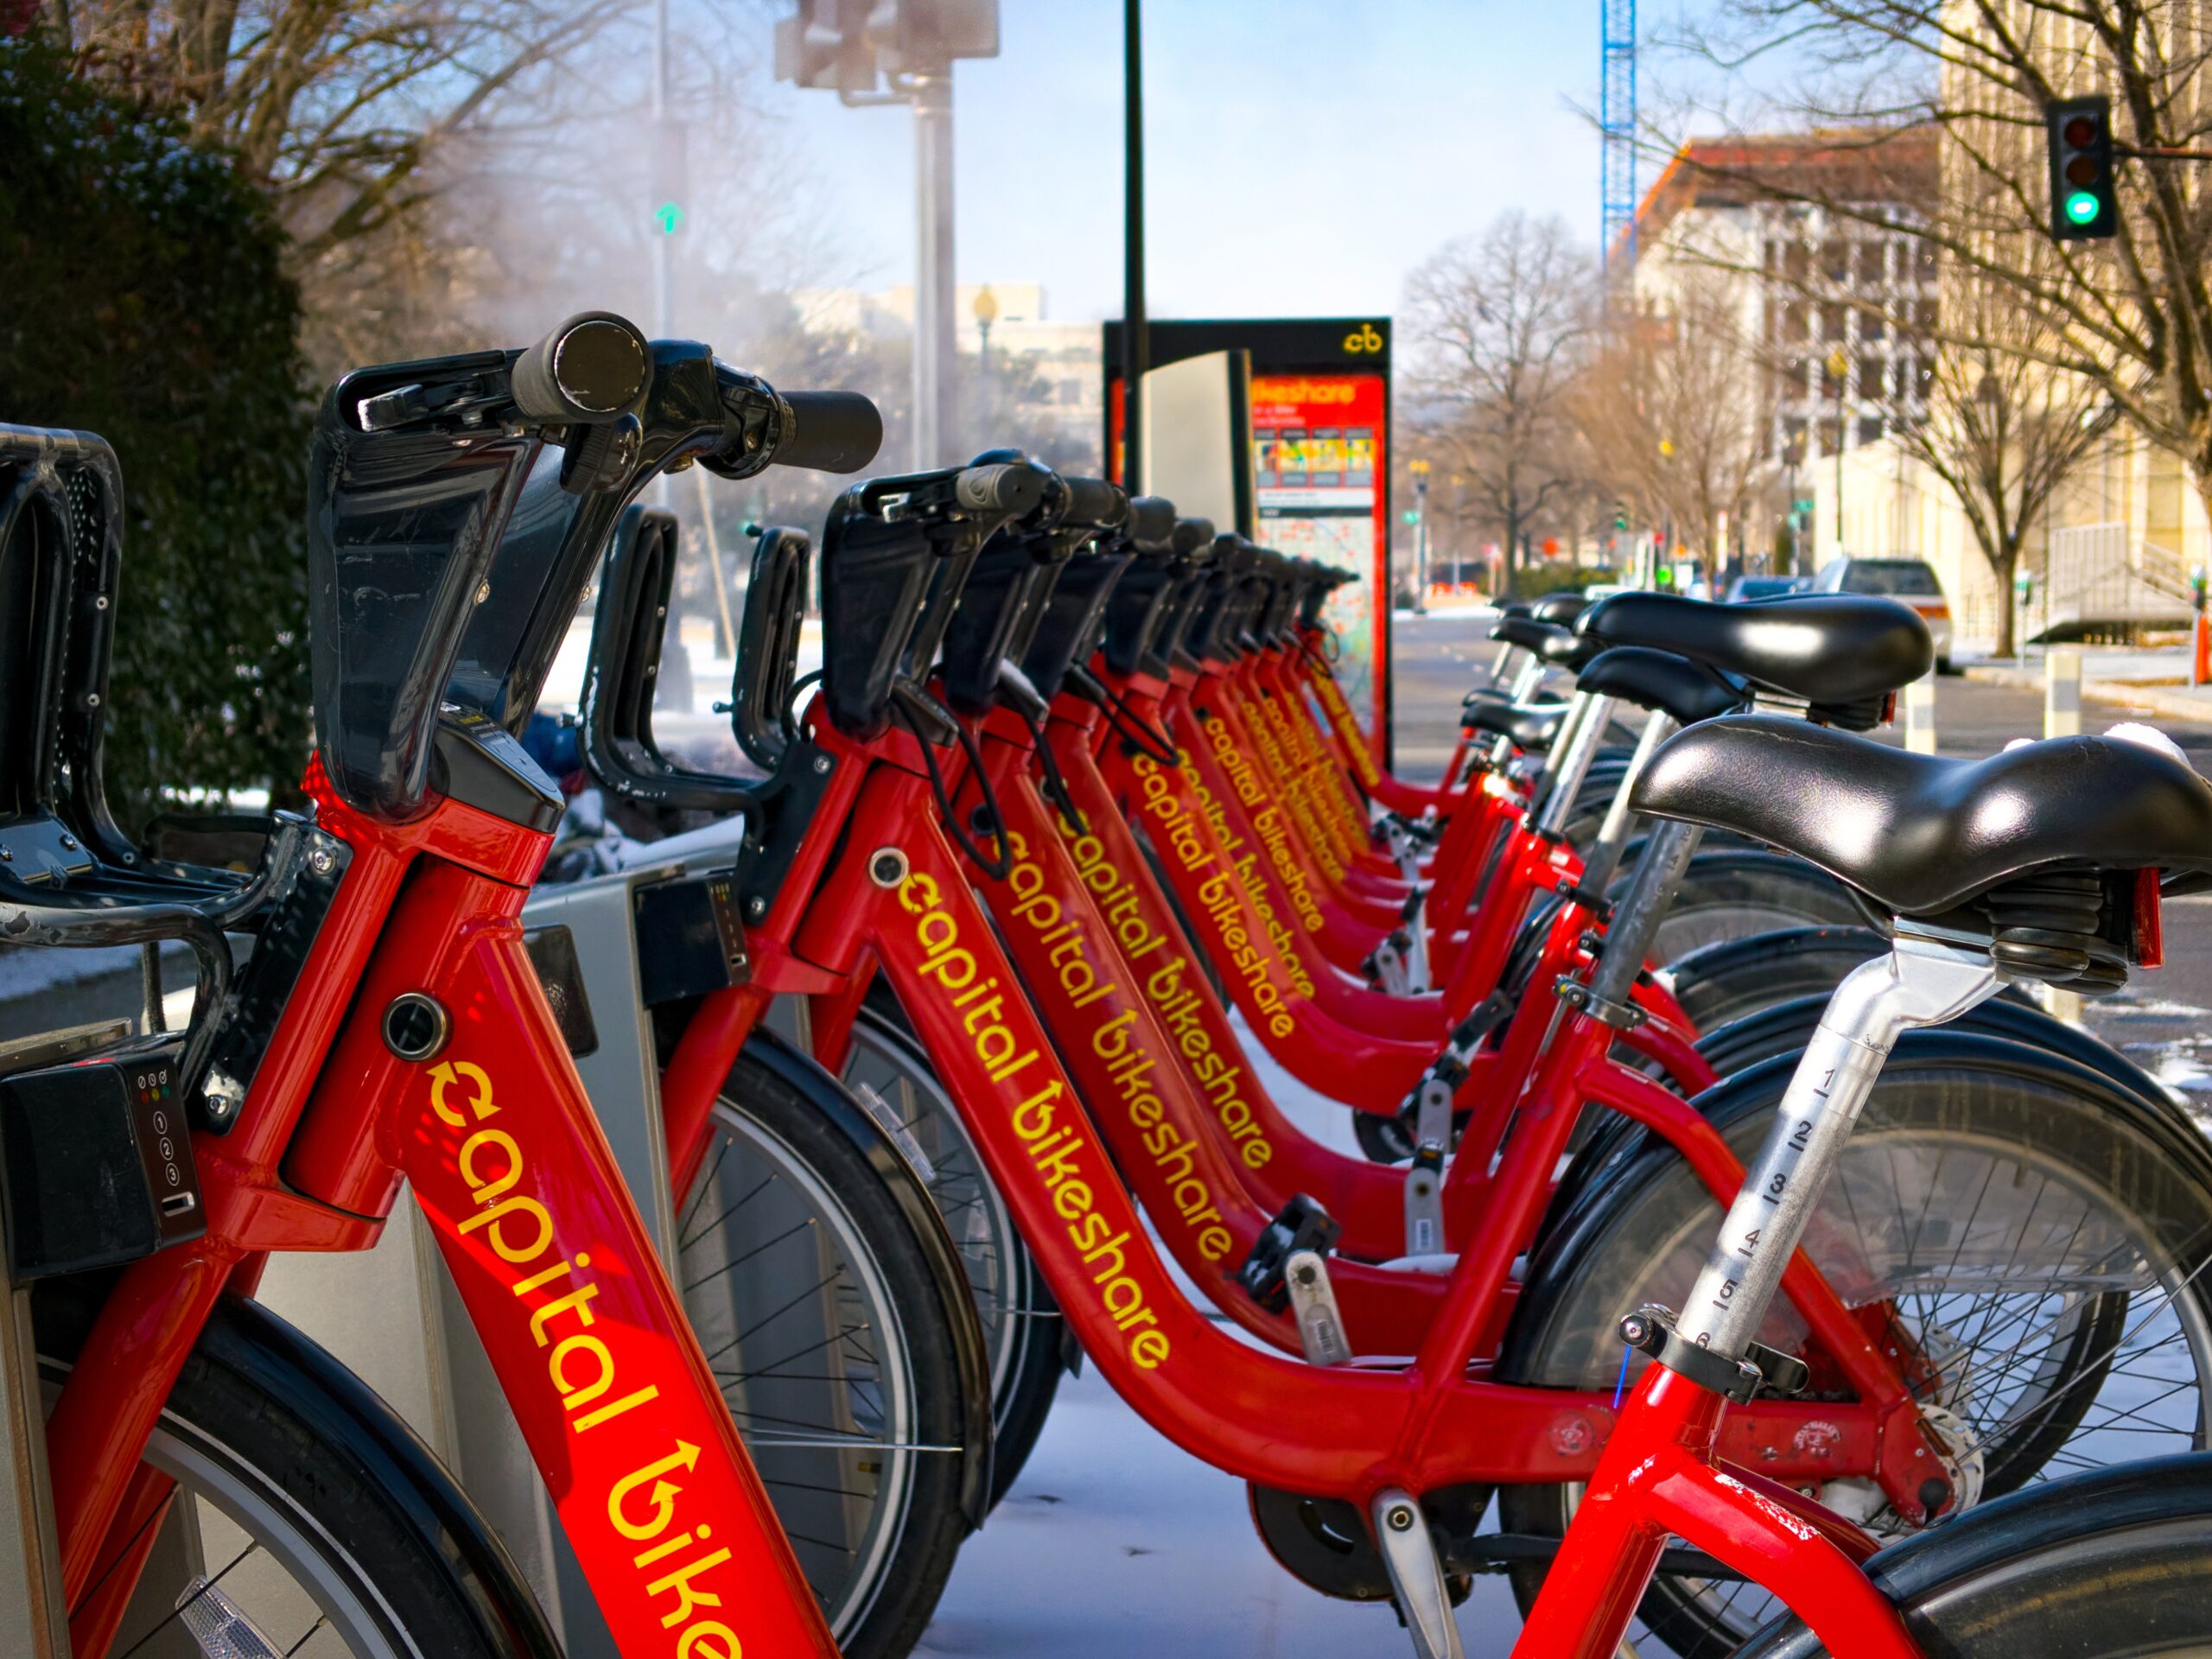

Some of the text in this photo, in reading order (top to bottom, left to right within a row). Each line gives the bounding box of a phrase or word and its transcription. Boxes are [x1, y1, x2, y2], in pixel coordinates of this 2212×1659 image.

[1344, 323, 1382, 353] cb
[1206, 717, 1325, 933] capital bikeshare
[1132, 753, 1295, 1038] capital bikeshare
[992, 830, 1232, 1262] capital bikeshare
[1058, 809, 1273, 1169] capital bikeshare
[898, 871, 1171, 1370] capital bikeshare
[1793, 1119, 1814, 1143] 2
[1823, 1068, 1836, 1089] 1
[1744, 1228, 1762, 1249] 4
[1769, 1172, 1788, 1195] 3
[425, 1060, 659, 1433] capital
[1719, 1278, 1739, 1300] 5
